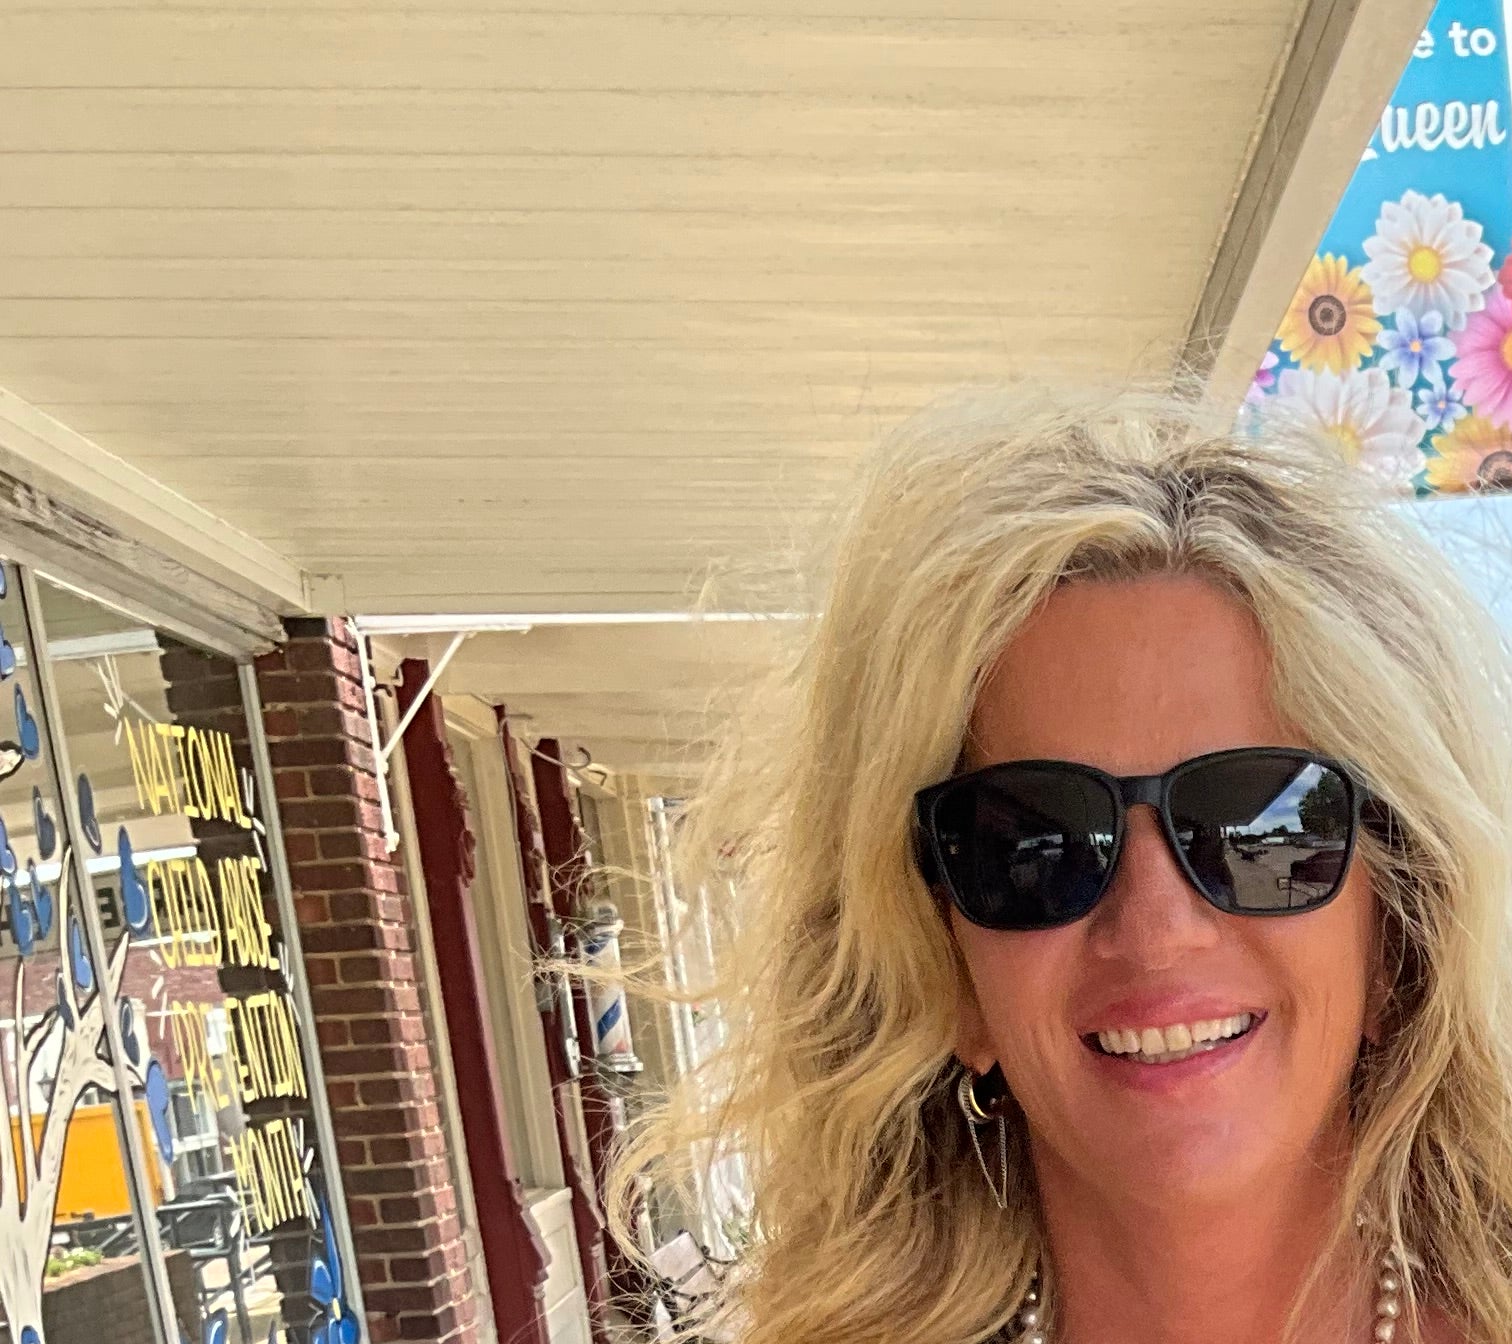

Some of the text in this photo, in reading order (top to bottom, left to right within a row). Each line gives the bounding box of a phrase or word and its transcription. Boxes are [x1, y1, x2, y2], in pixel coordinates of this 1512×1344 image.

[1448, 21, 1496, 57] to
[1361, 100, 1506, 161] ueen
[124, 717, 252, 829] NATIONAL
[148, 858, 222, 969] CHILD
[218, 855, 280, 970] ABUSE
[230, 1117, 311, 1237] MONTH
